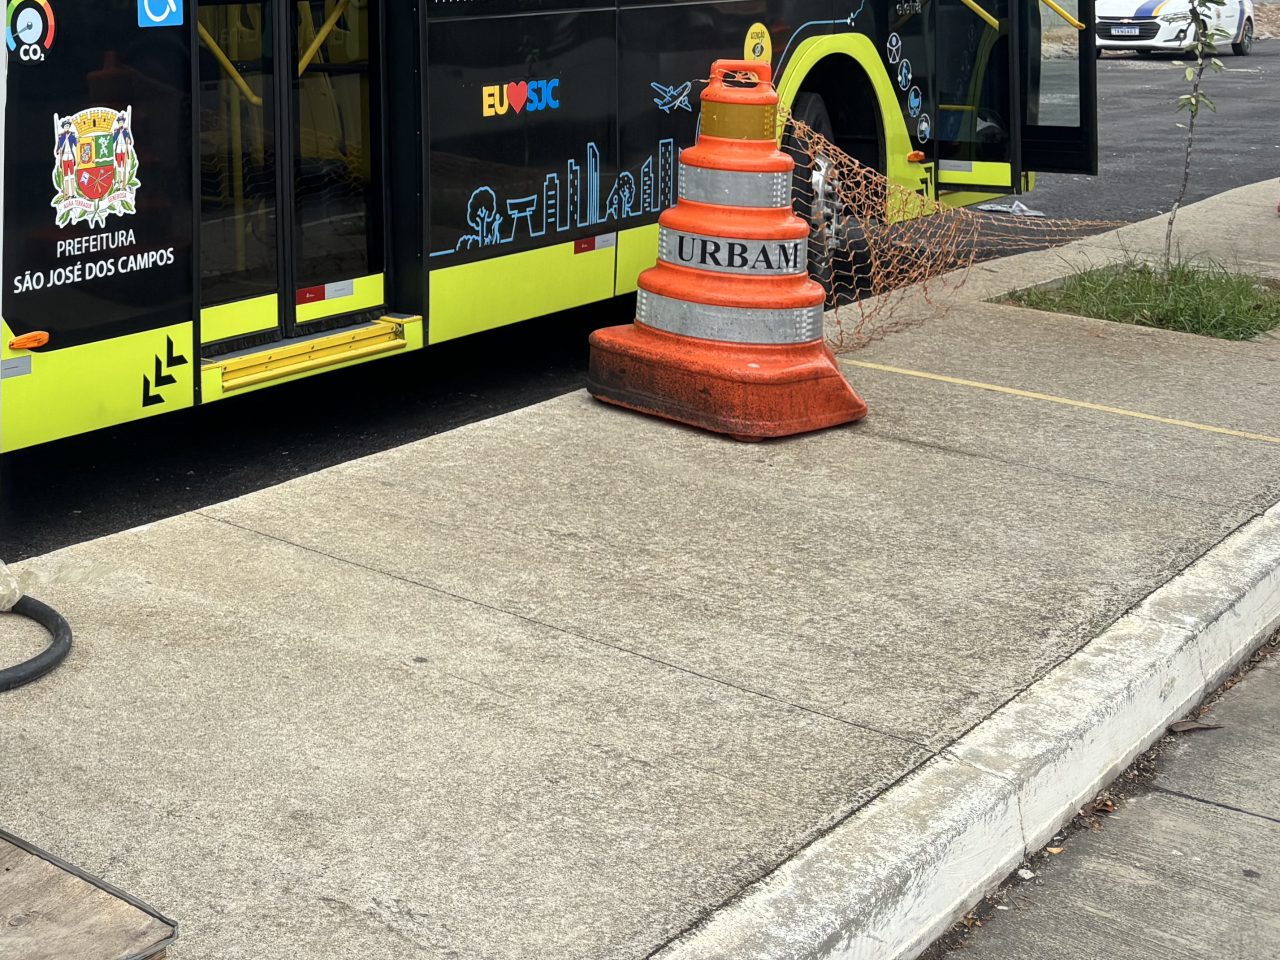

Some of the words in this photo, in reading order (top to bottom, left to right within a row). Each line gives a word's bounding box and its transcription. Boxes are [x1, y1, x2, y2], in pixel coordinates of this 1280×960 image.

[482, 84, 509, 117] EU
[526, 78, 560, 112] SJC
[56, 228, 135, 259] PREFEITURA
[677, 235, 799, 270] URBAM
[13, 271, 45, 294] SÃO
[47, 262, 81, 288] JOSÉ
[85, 255, 115, 279] DOS
[118, 247, 175, 275] CAMPOS
